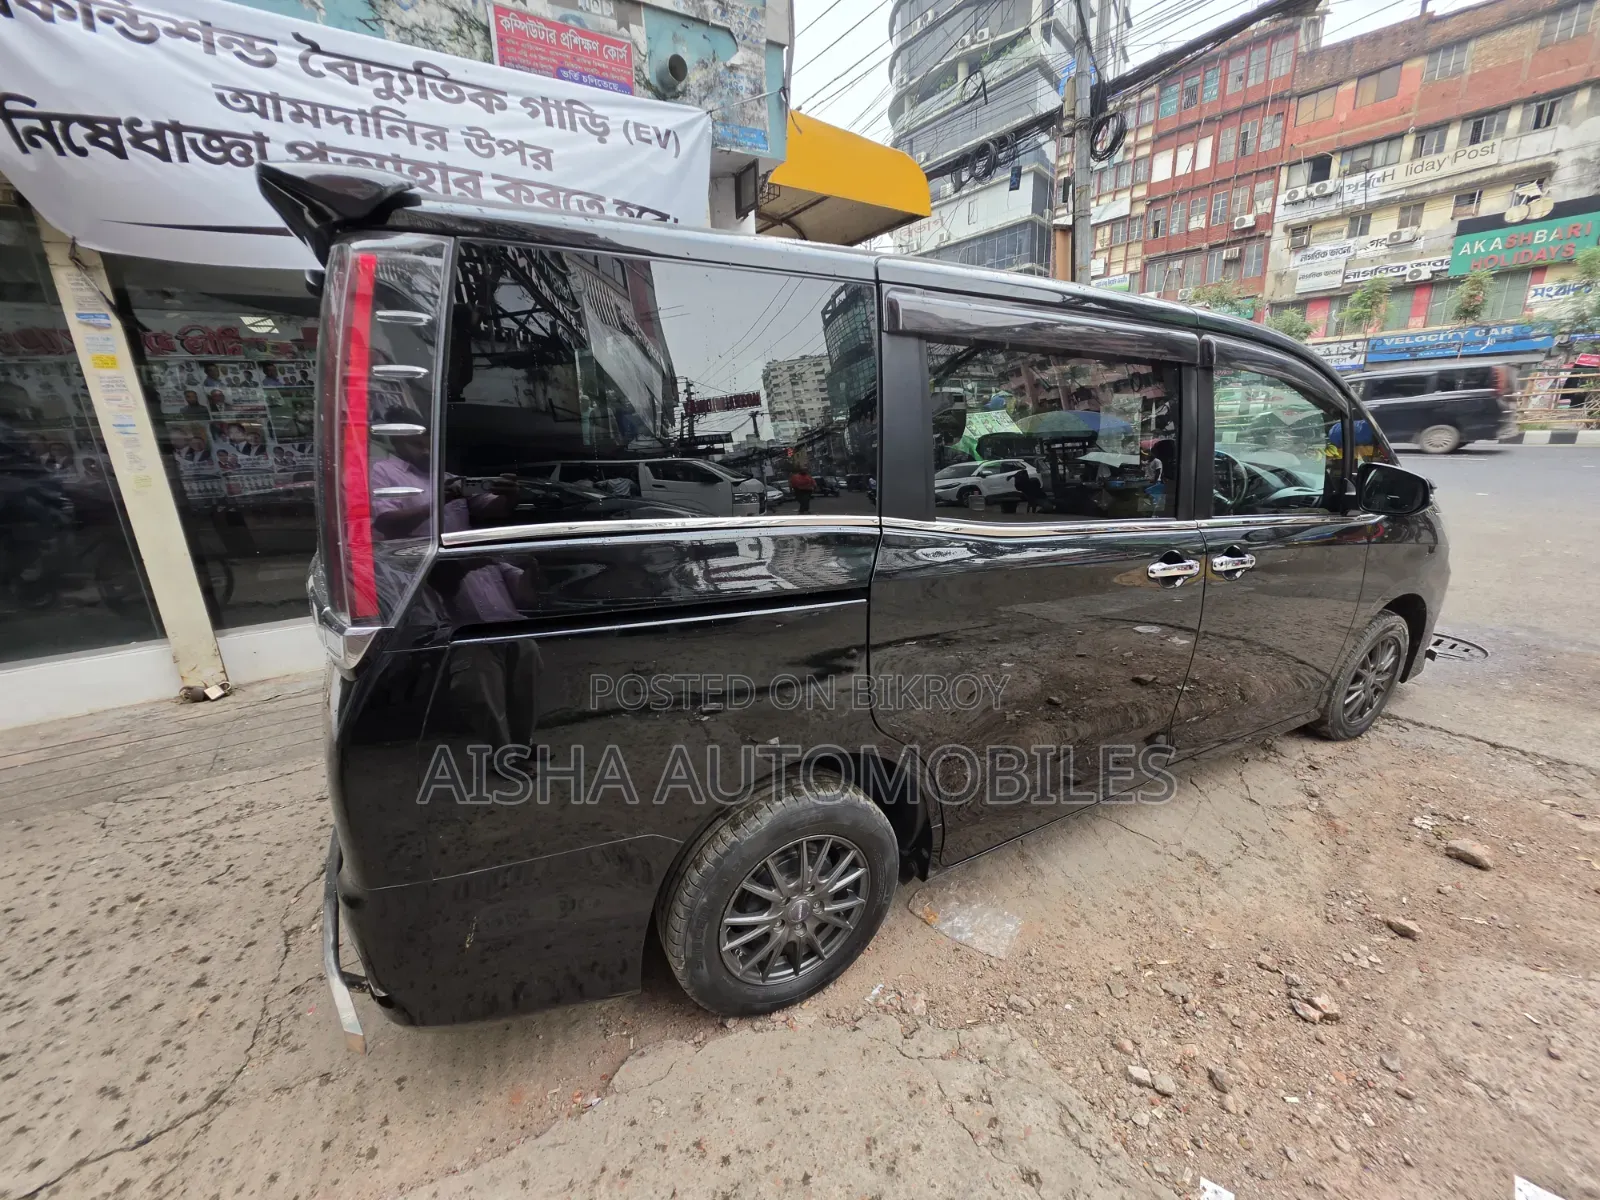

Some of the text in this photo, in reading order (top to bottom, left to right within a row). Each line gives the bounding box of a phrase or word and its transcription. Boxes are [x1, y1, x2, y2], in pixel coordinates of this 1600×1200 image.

[498, 12, 557, 45] কম্পিউটার
[560, 28, 600, 57] প্রশিক্ষণ
[602, 44, 628, 64] কোর্স
[0, 0, 278, 68] কন্ডিশন্ড
[291, 32, 507, 114] বৈদ্যুতিক
[519, 95, 611, 144] গাড়ি
[622, 119, 681, 158] (EV)
[0, 91, 271, 168] নিষেধাজ্ঞা
[211, 83, 554, 171] আমদানির উপর
[1453, 141, 1497, 165] Post
[1458, 220, 1593, 256] AKASHBARI
[1469, 242, 1577, 271] HOLIDAYS
[1383, 330, 1470, 346] VELOCITY
